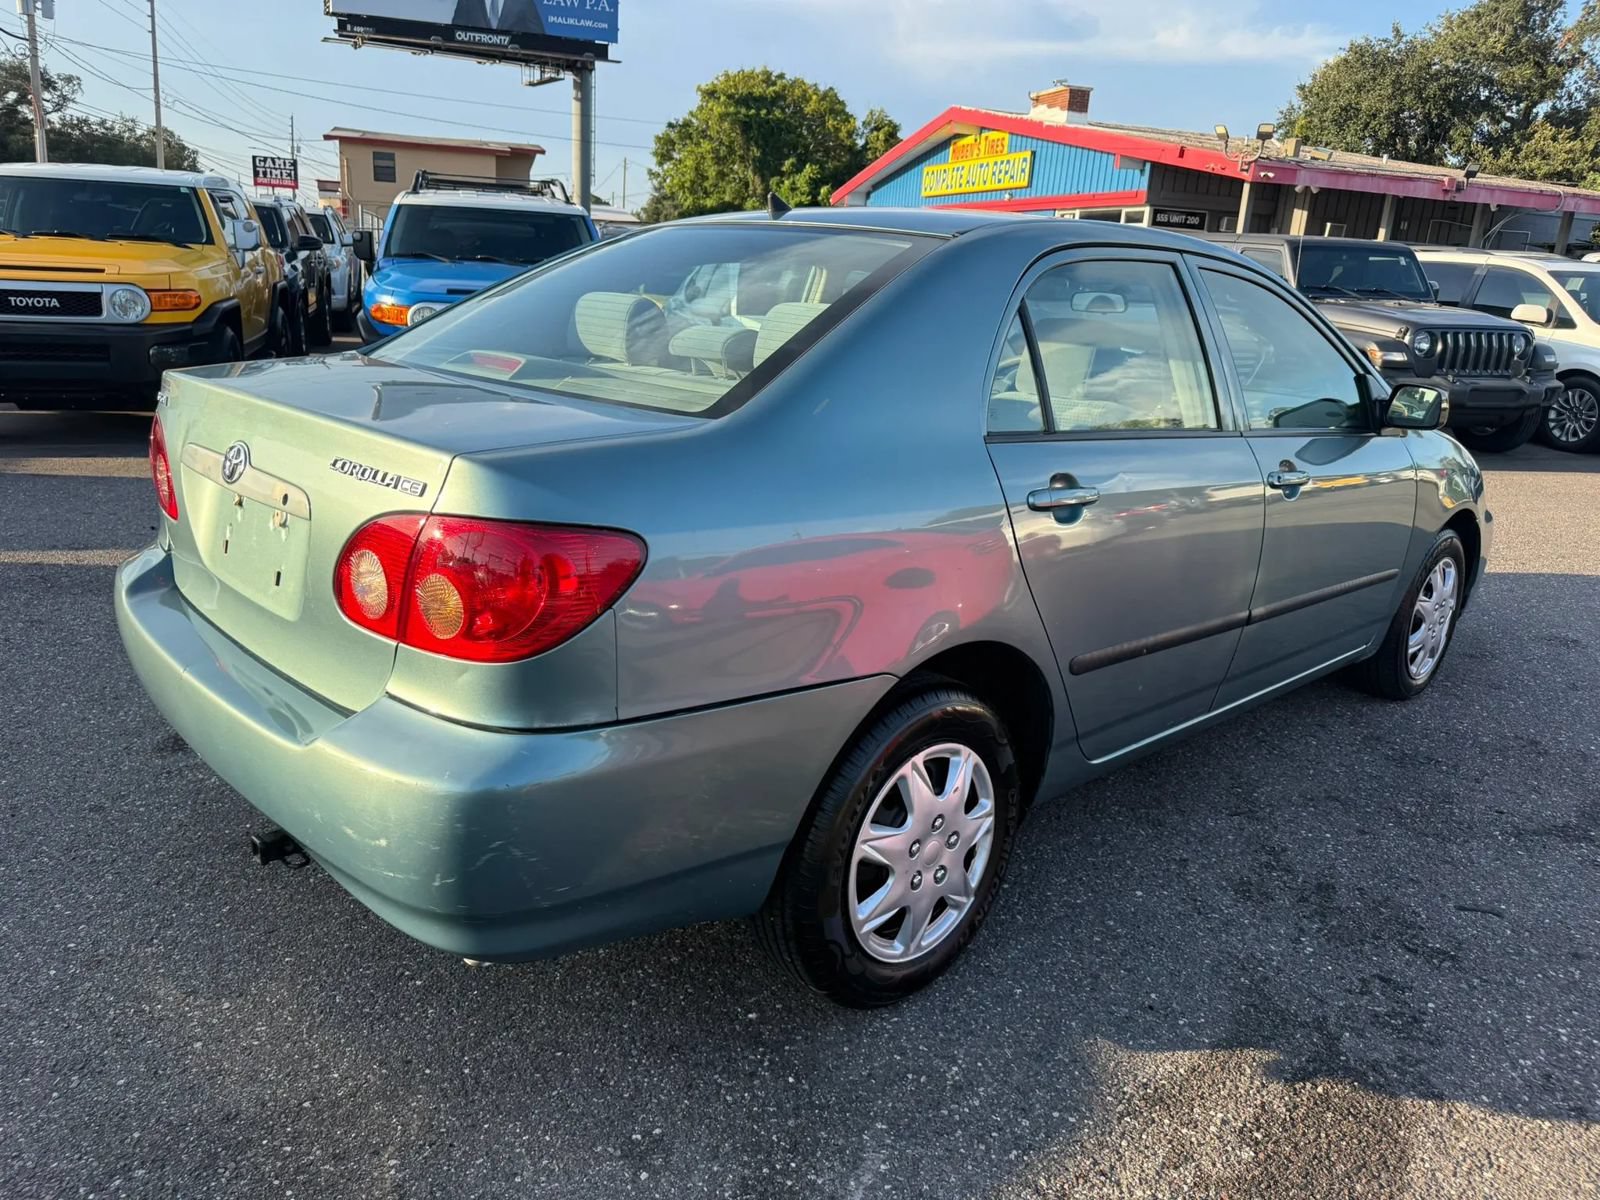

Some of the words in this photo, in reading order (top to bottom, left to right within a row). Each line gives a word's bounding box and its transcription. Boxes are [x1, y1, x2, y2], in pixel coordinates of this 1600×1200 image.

[984, 135, 1006, 156] TIRES
[256, 157, 294, 169] GAME
[256, 168, 294, 179] TIME!
[924, 166, 965, 192] COMPLETE
[966, 163, 989, 187] AUTO
[991, 158, 1028, 185] REPAIR
[1169, 215, 1186, 224] UNIT
[1186, 216, 1200, 225] 200
[8, 296, 61, 307] TOYOTA
[330, 456, 401, 490] COROLLA
[400, 478, 422, 495] CE
